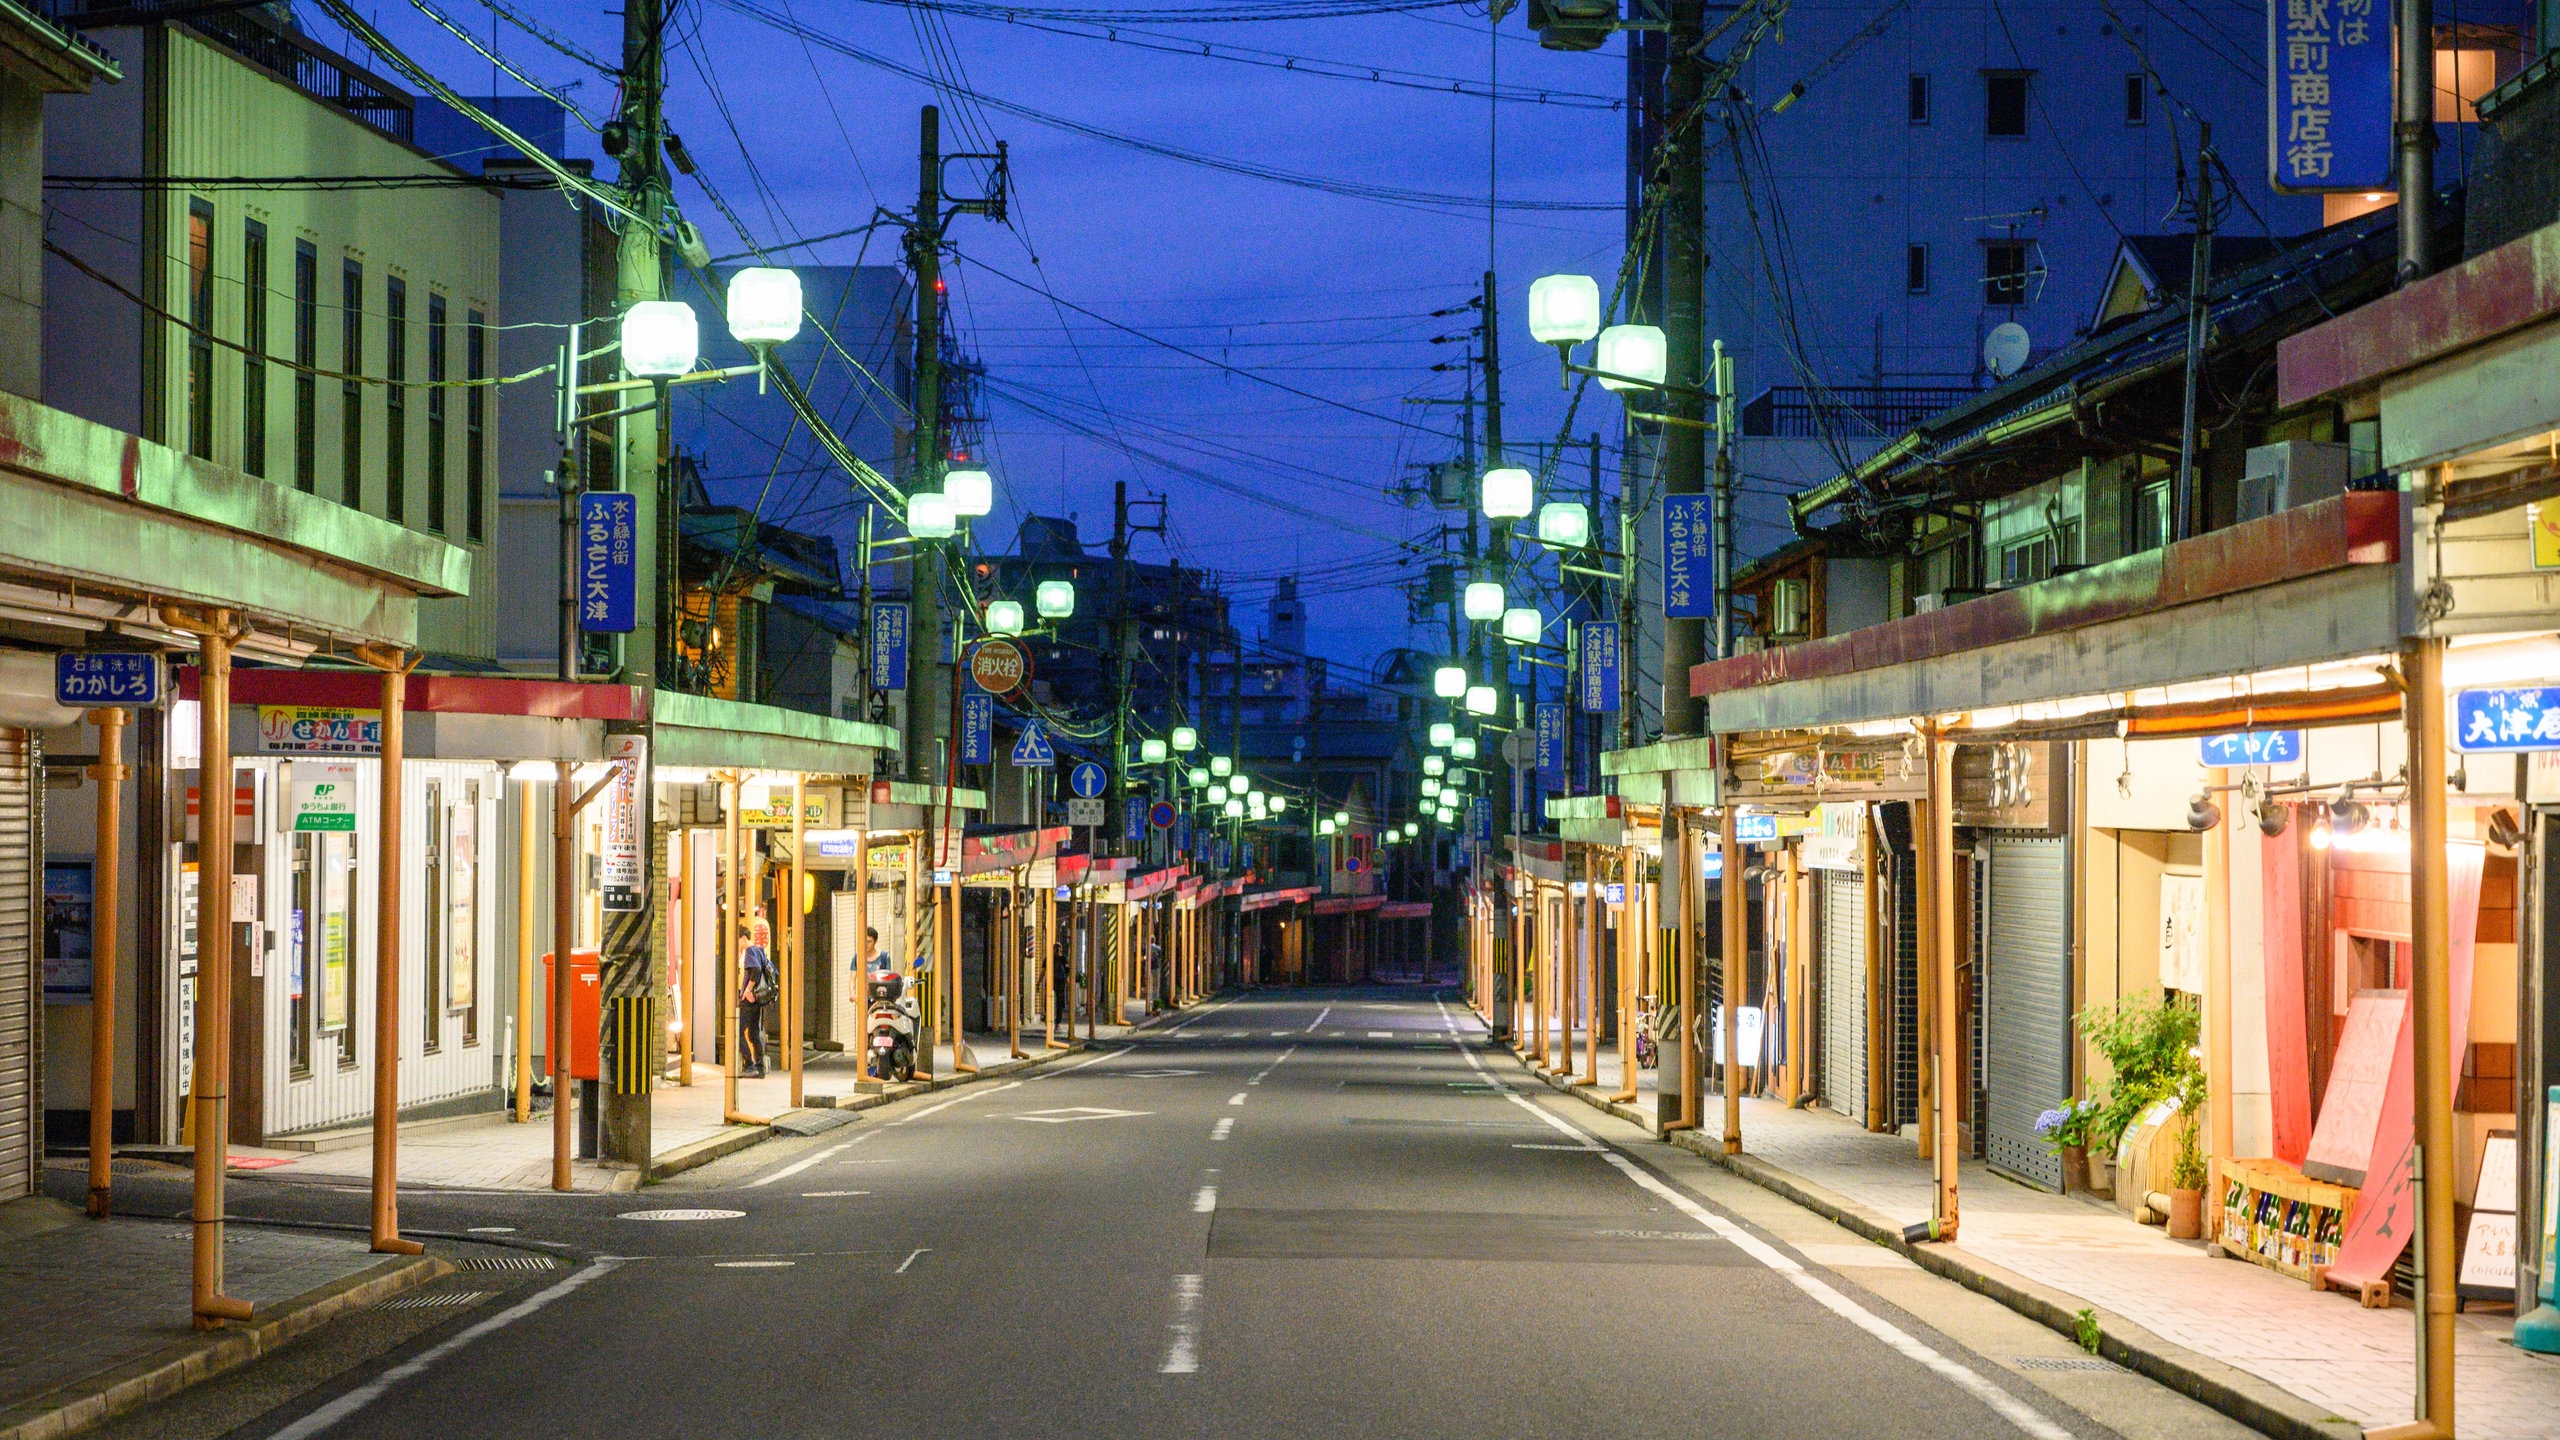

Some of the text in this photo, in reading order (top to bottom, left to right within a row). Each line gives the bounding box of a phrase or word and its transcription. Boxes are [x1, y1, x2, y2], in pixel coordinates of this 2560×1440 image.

[612, 500, 631, 565] 水と緑の街
[1668, 505, 1690, 607] ふるさと大津
[1691, 500, 1707, 557] 水と緑の街
[586, 503, 610, 621] ふるさと大津
[65, 675, 148, 696] わかしろ
[976, 656, 1019, 678] 消火栓
[1586, 626, 1602, 710] 大津駅前商店街
[301, 802, 346, 811] ゆうちょ銀行
[302, 816, 350, 824] ATMコーナー
[182, 983, 191, 1091] 夜間警戒強化中
